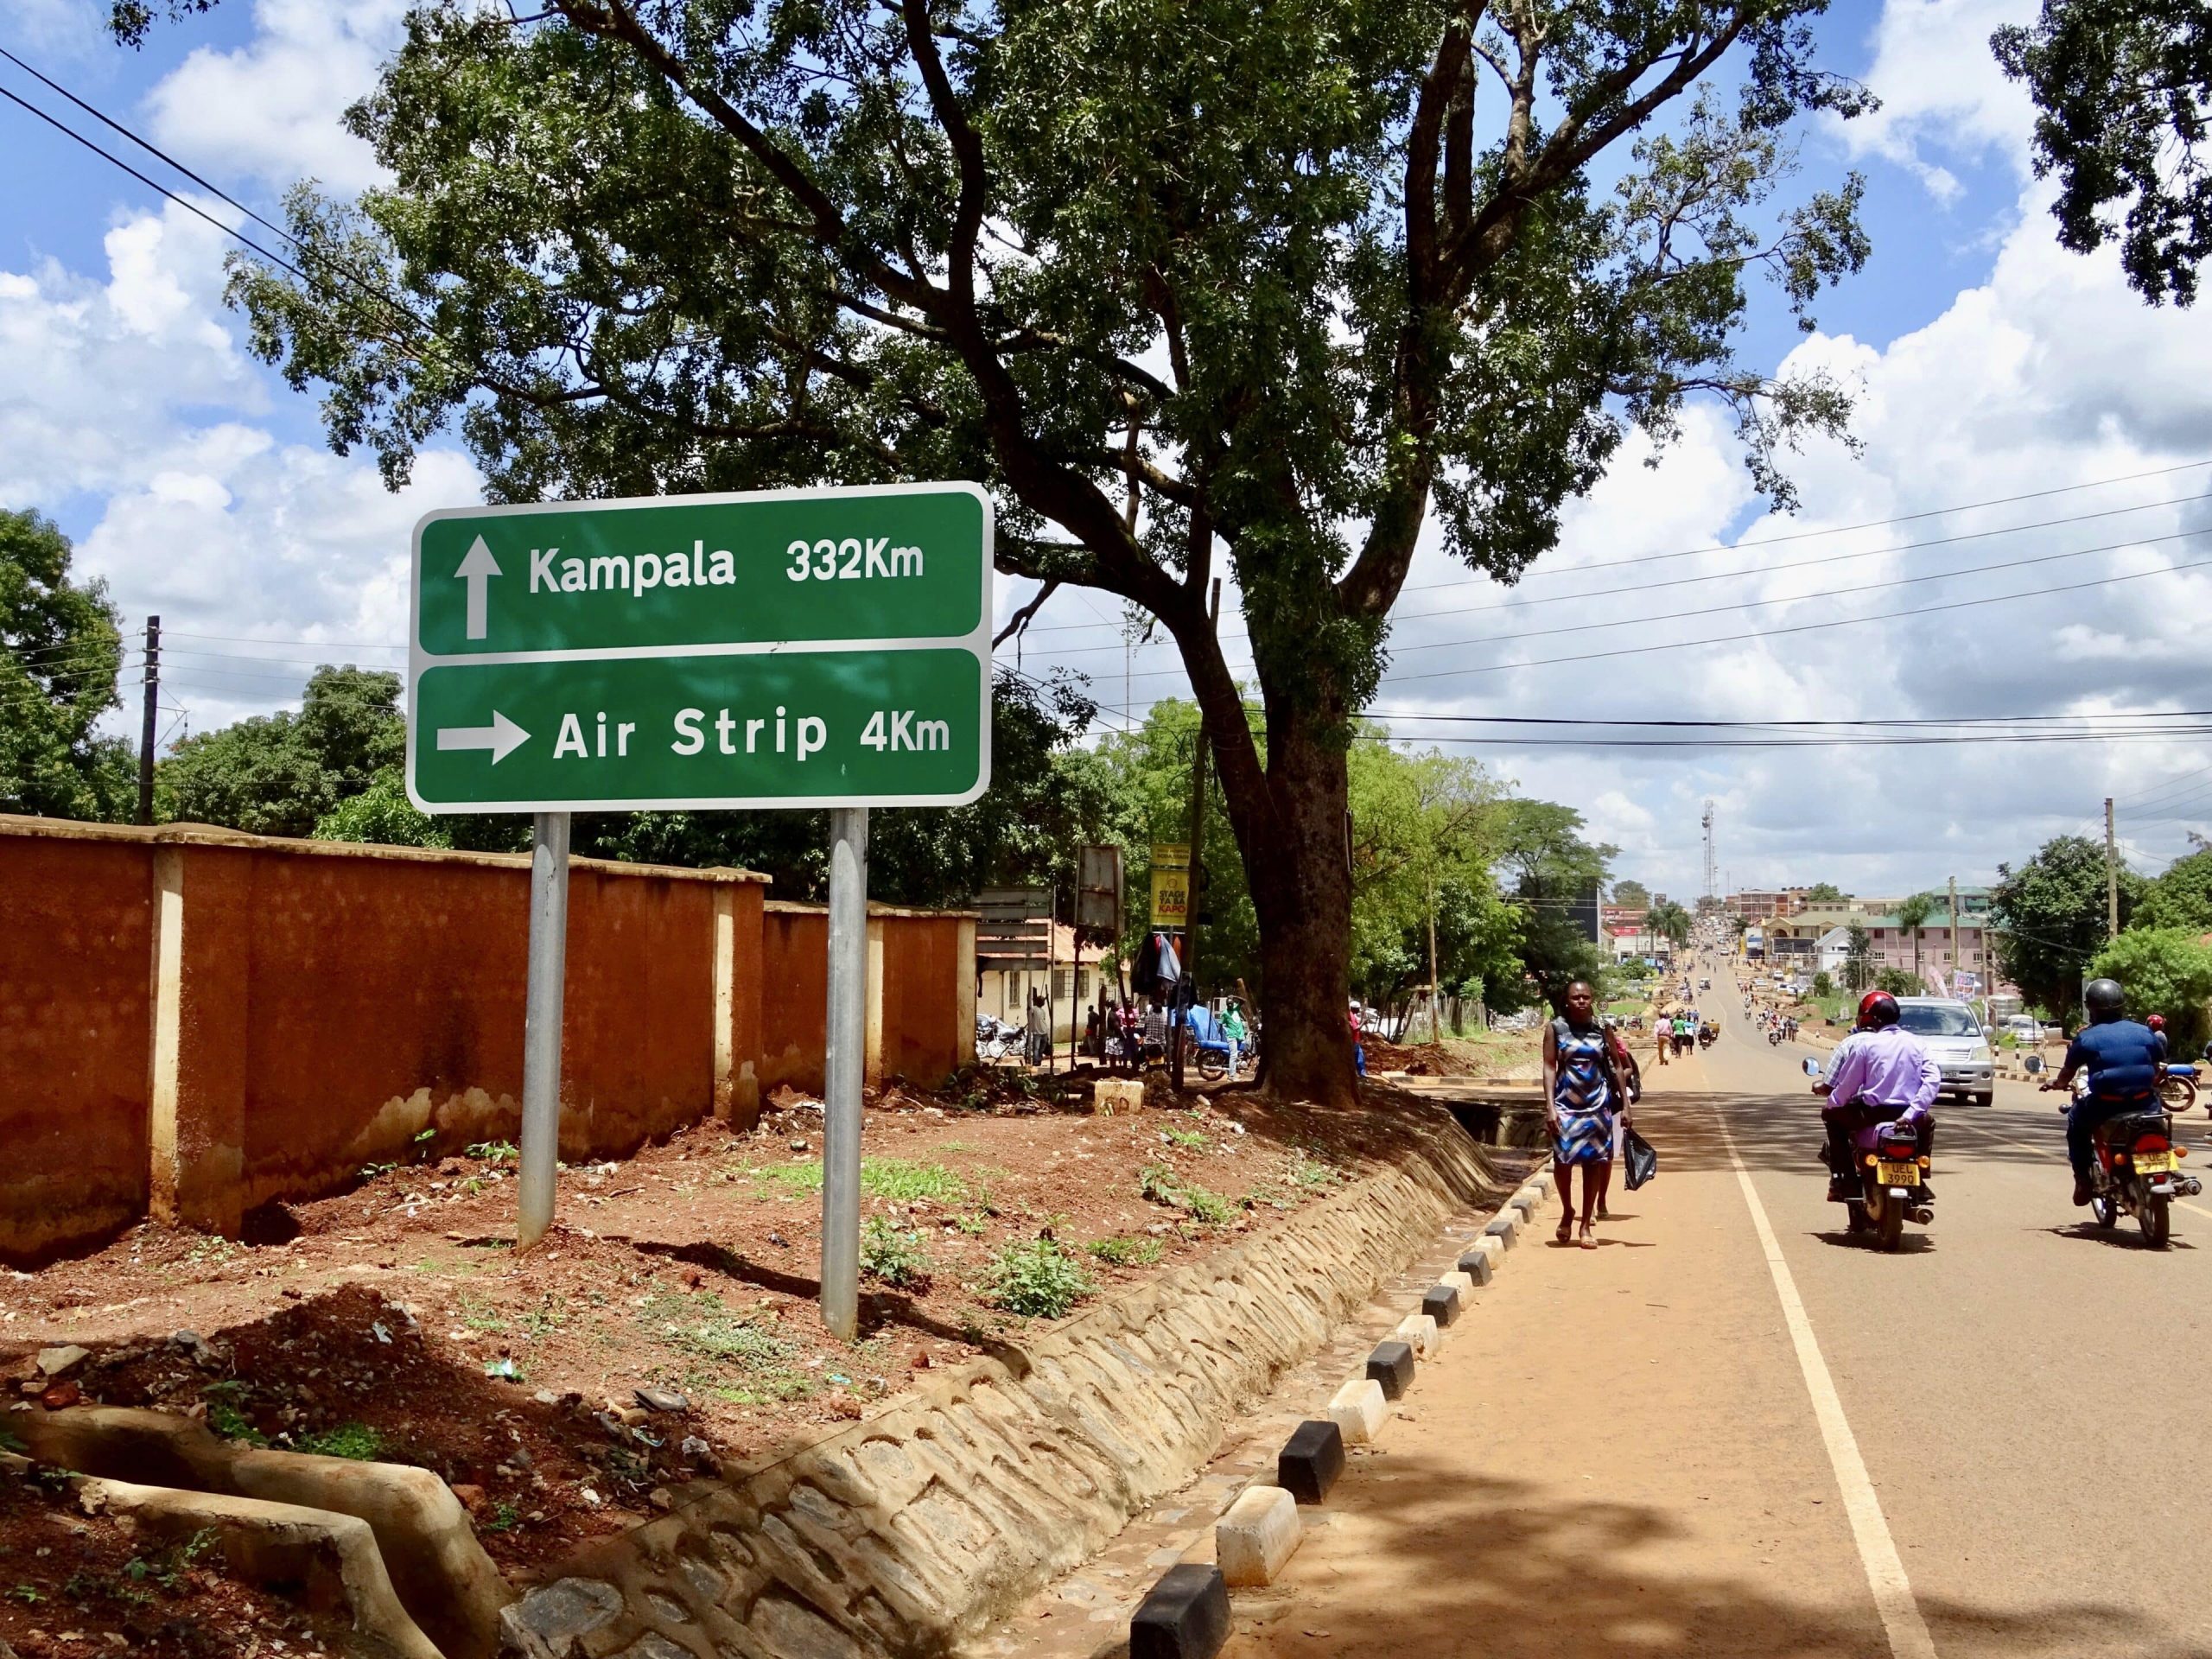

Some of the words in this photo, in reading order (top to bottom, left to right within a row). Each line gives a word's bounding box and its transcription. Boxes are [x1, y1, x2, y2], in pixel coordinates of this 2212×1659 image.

[530, 540, 736, 597] Kampala
[785, 537, 924, 582] 332Km
[552, 711, 636, 759] Air
[670, 705, 827, 761] Strip
[860, 710, 950, 752] 4Km
[1158, 905, 1186, 913] KAPO
[1892, 1164, 1913, 1174] UEL
